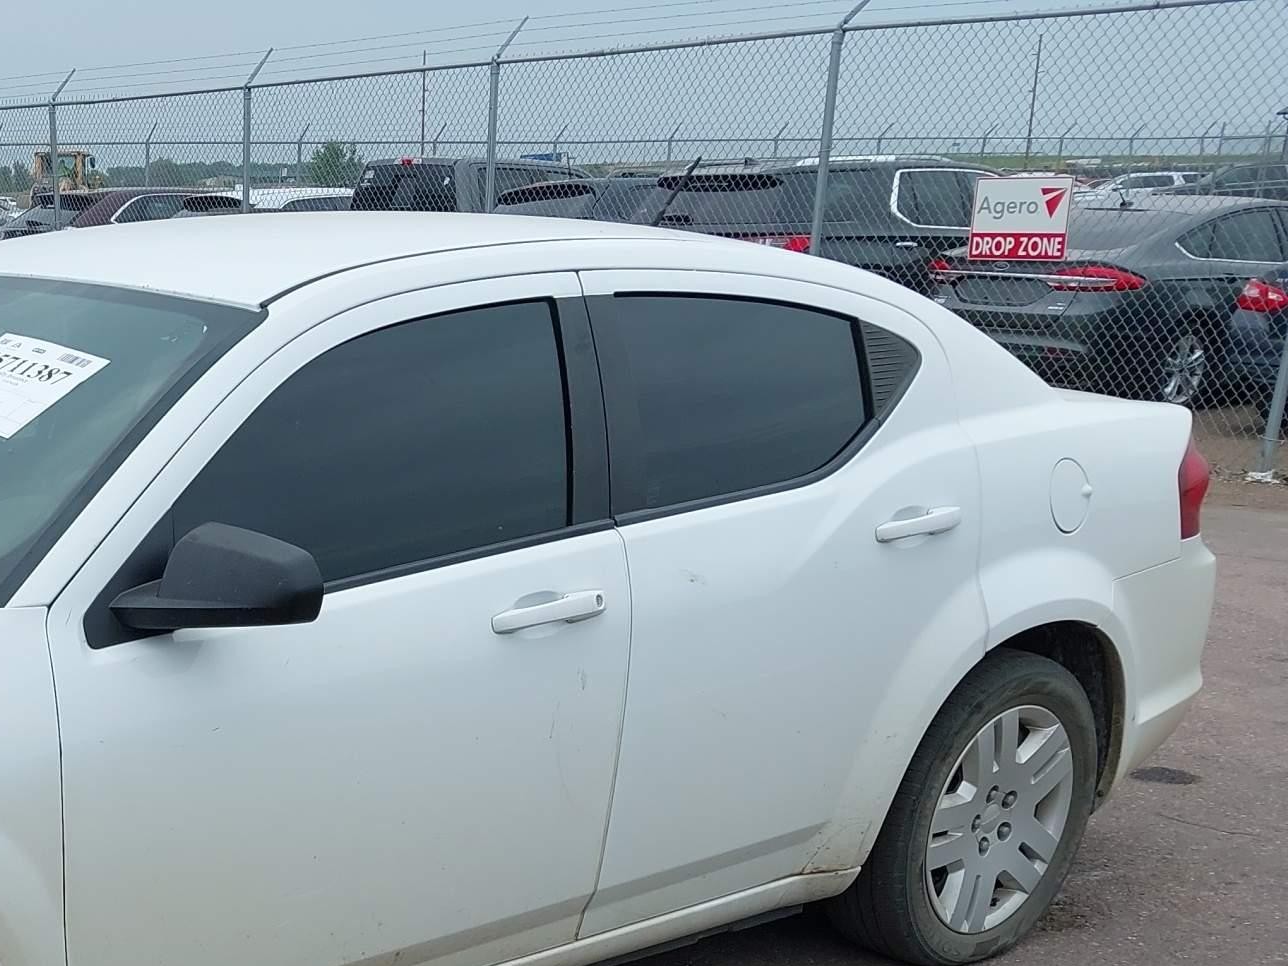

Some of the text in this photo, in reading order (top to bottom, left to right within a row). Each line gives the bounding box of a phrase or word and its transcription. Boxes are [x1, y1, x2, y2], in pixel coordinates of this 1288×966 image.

[976, 195, 1039, 220] Agero
[972, 236, 1063, 257] DROP ZONE
